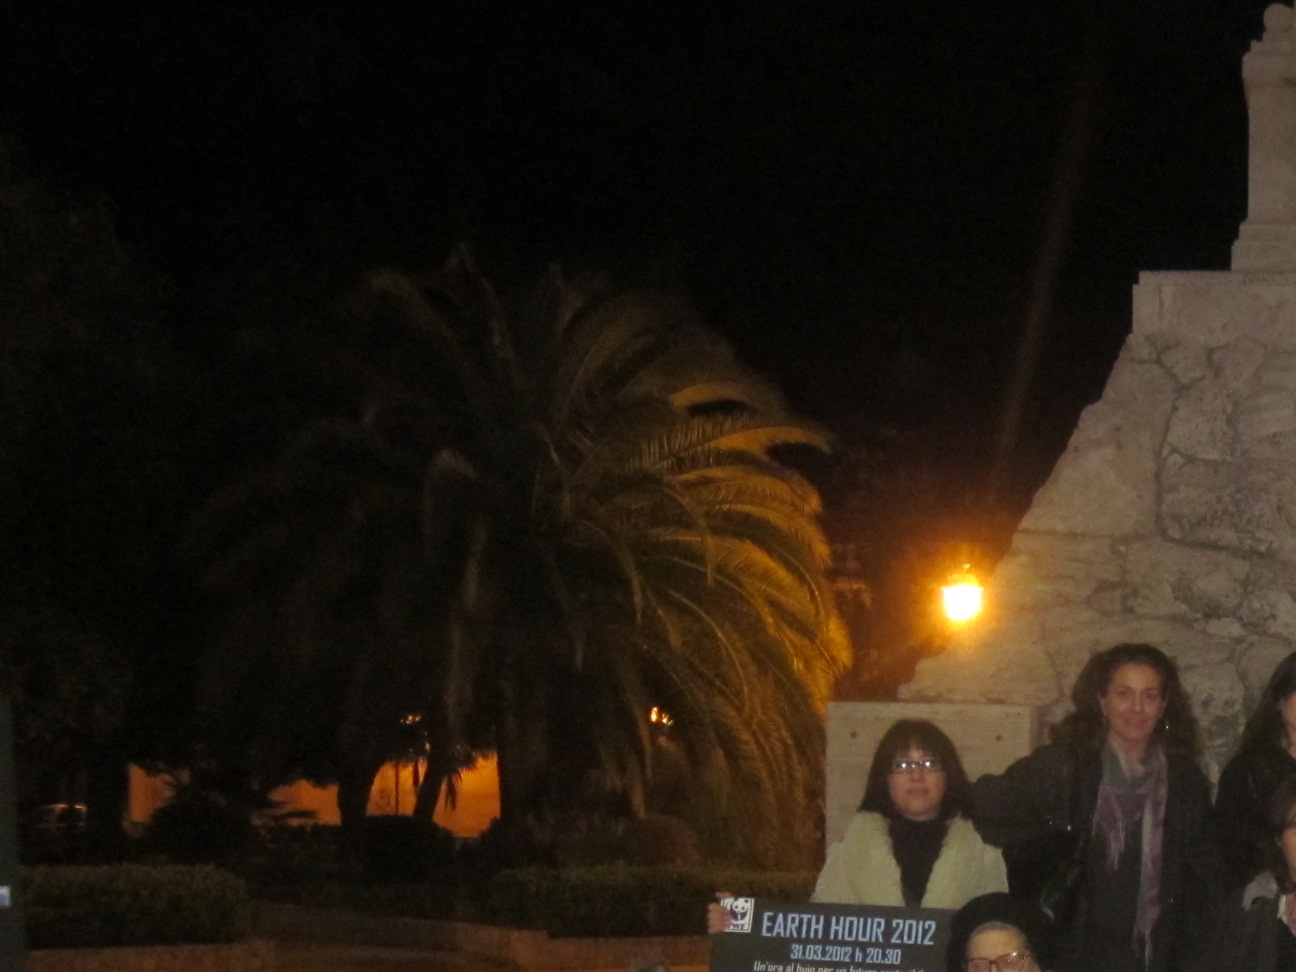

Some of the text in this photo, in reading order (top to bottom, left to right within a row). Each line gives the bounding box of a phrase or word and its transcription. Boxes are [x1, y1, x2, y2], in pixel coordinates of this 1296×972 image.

[761, 911, 935, 945] EARTH HOUR 2012
[790, 943, 901, 964] 31.03.2012 h 20.30
[753, 960, 782, 972] Un'ora
[786, 962, 793, 972] al
